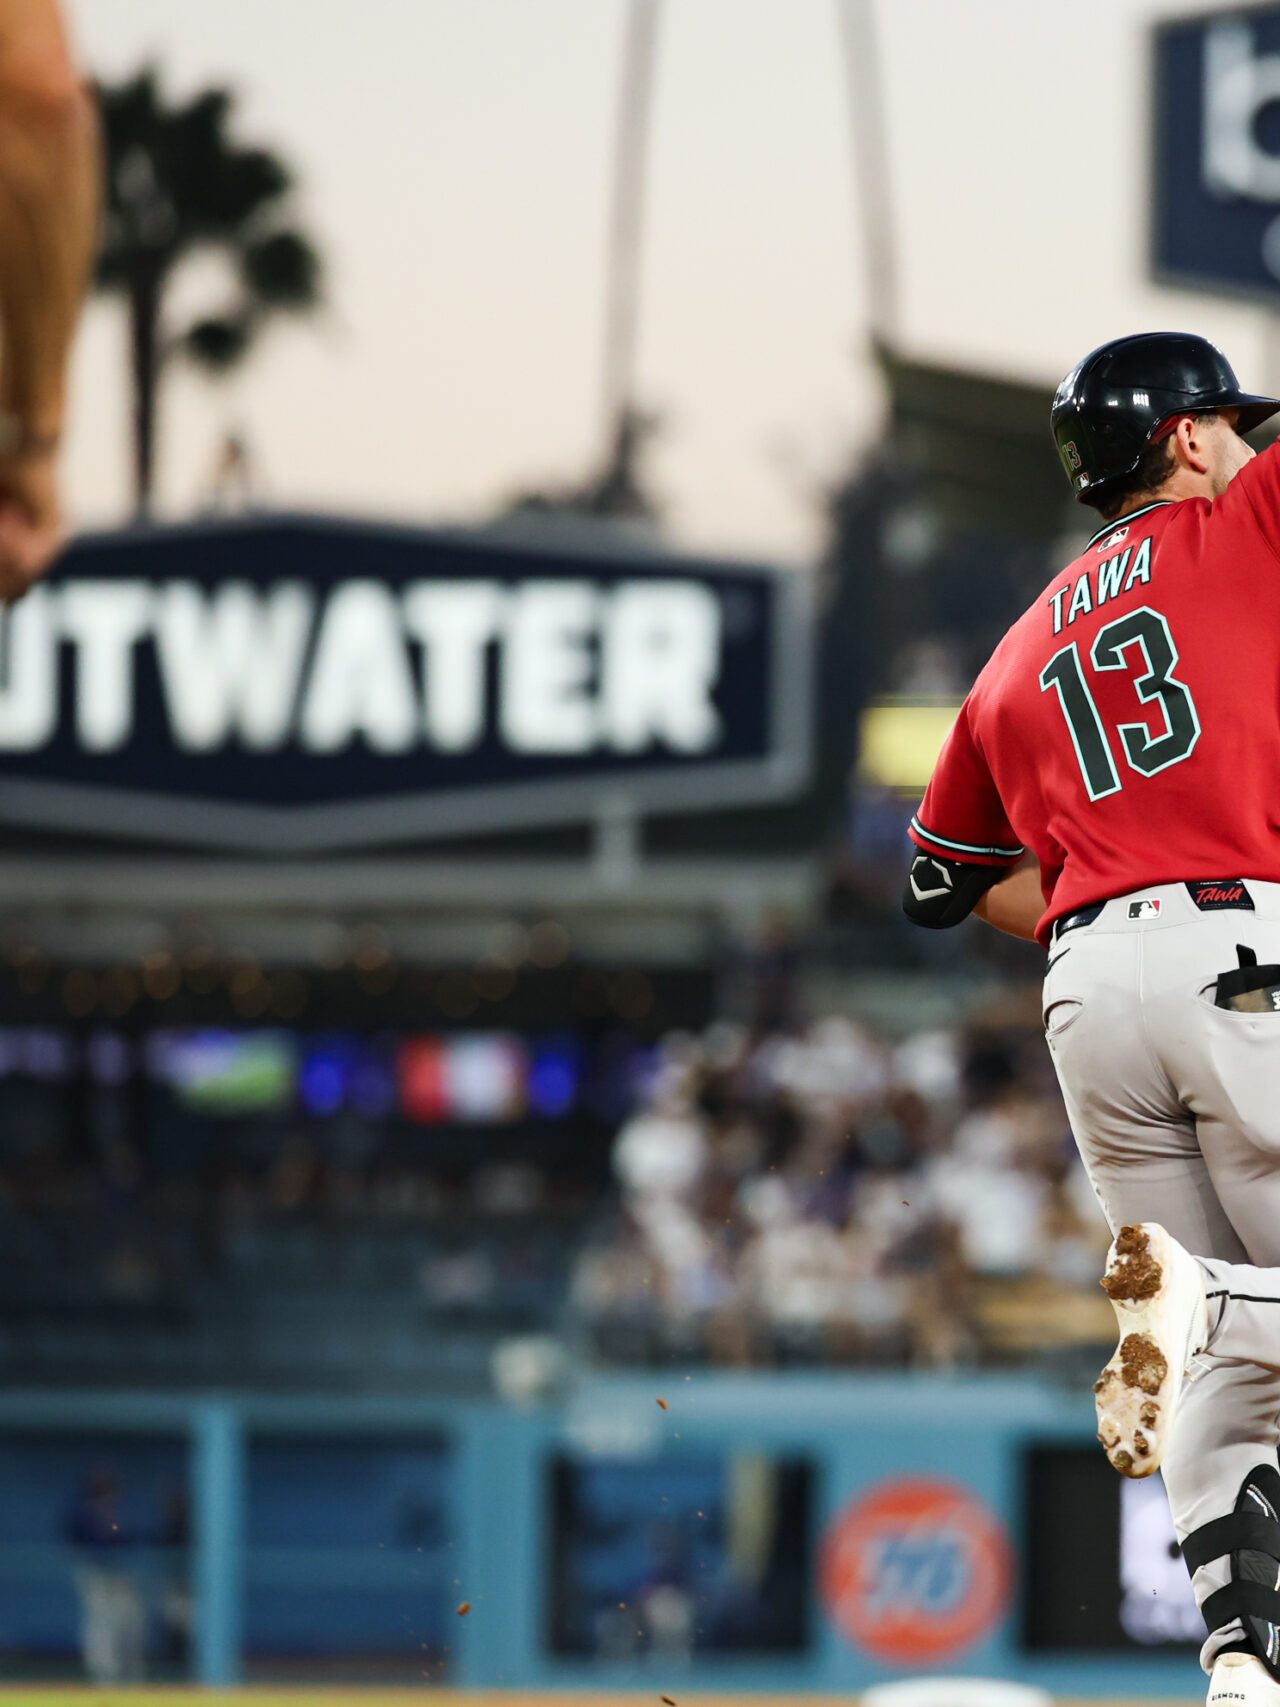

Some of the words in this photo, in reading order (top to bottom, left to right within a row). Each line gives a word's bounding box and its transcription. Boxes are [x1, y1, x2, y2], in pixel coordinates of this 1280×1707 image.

[1049, 535, 1152, 635] TAWA
[1038, 605, 1202, 802] 13
[1196, 887, 1244, 904] TAWA
